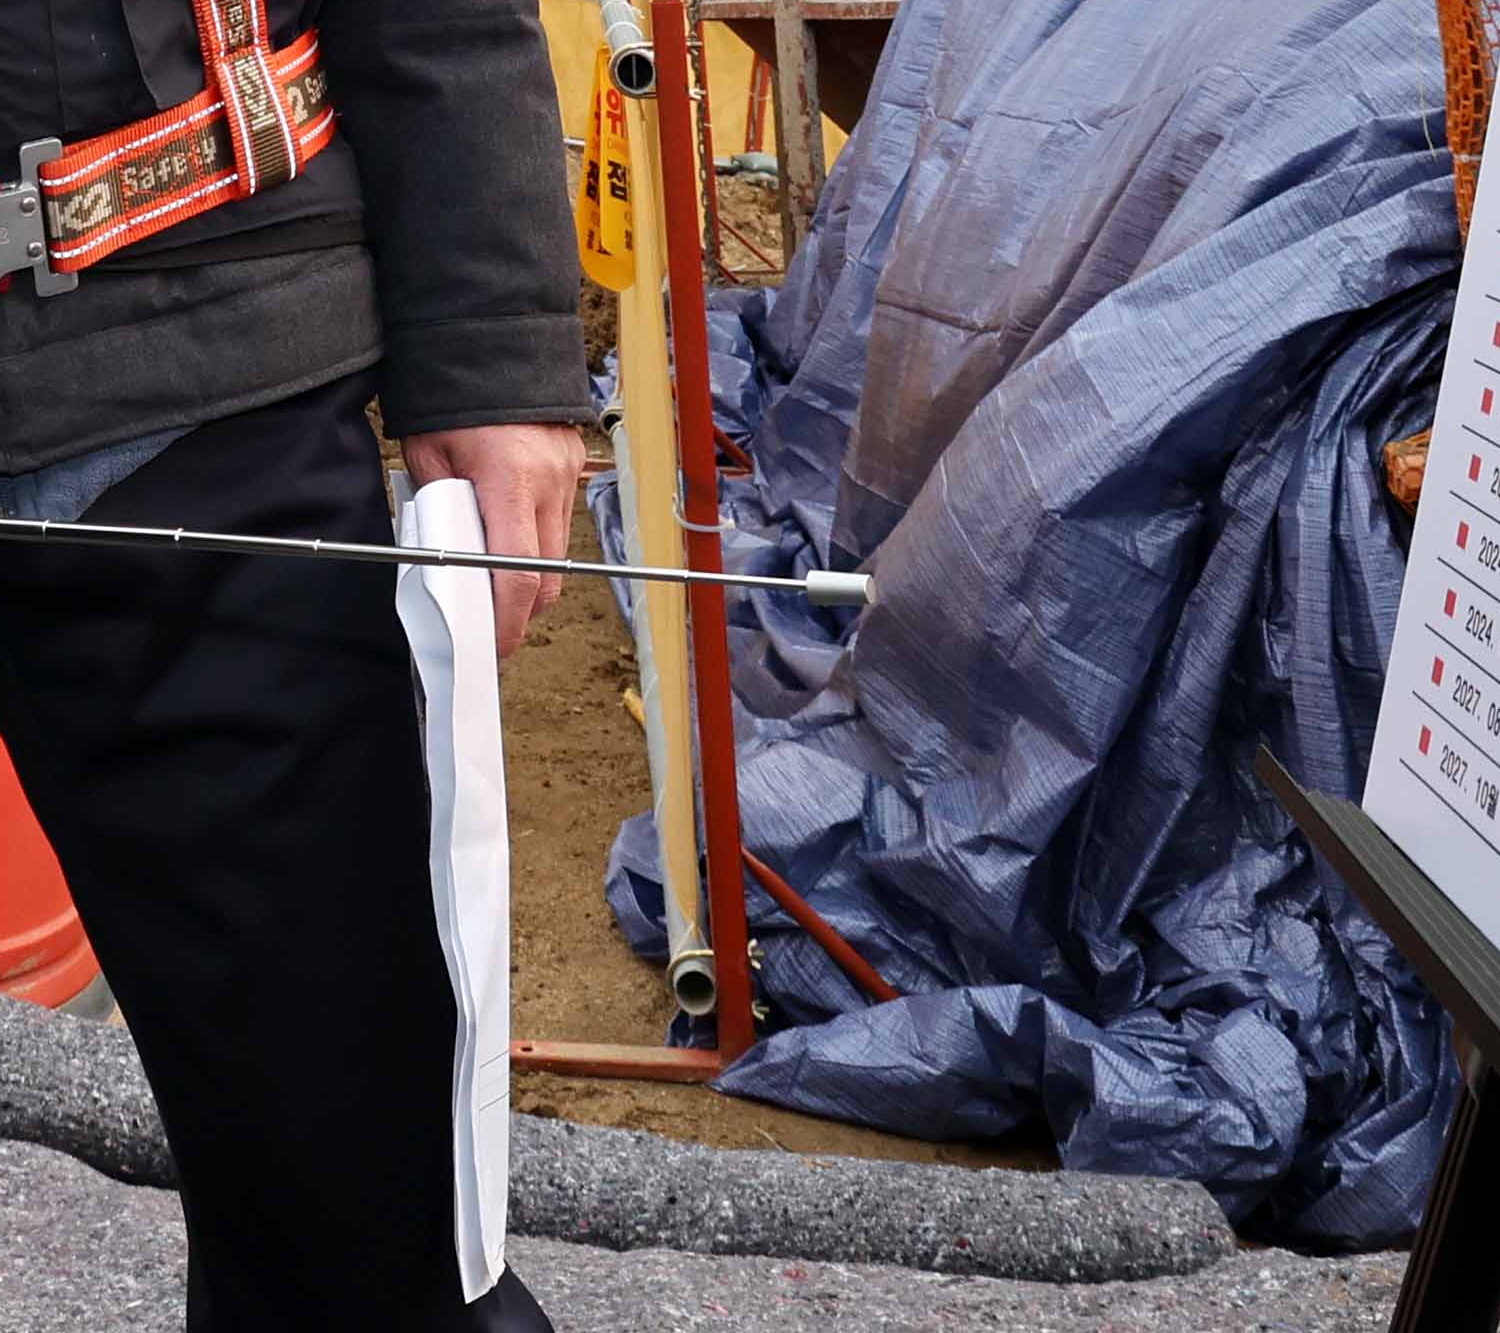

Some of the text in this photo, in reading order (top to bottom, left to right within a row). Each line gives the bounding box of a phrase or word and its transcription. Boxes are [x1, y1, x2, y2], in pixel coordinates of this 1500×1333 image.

[47, 182, 113, 239] K2
[1439, 745, 1468, 795] 2027.
[1475, 775, 1499, 821] 10월
